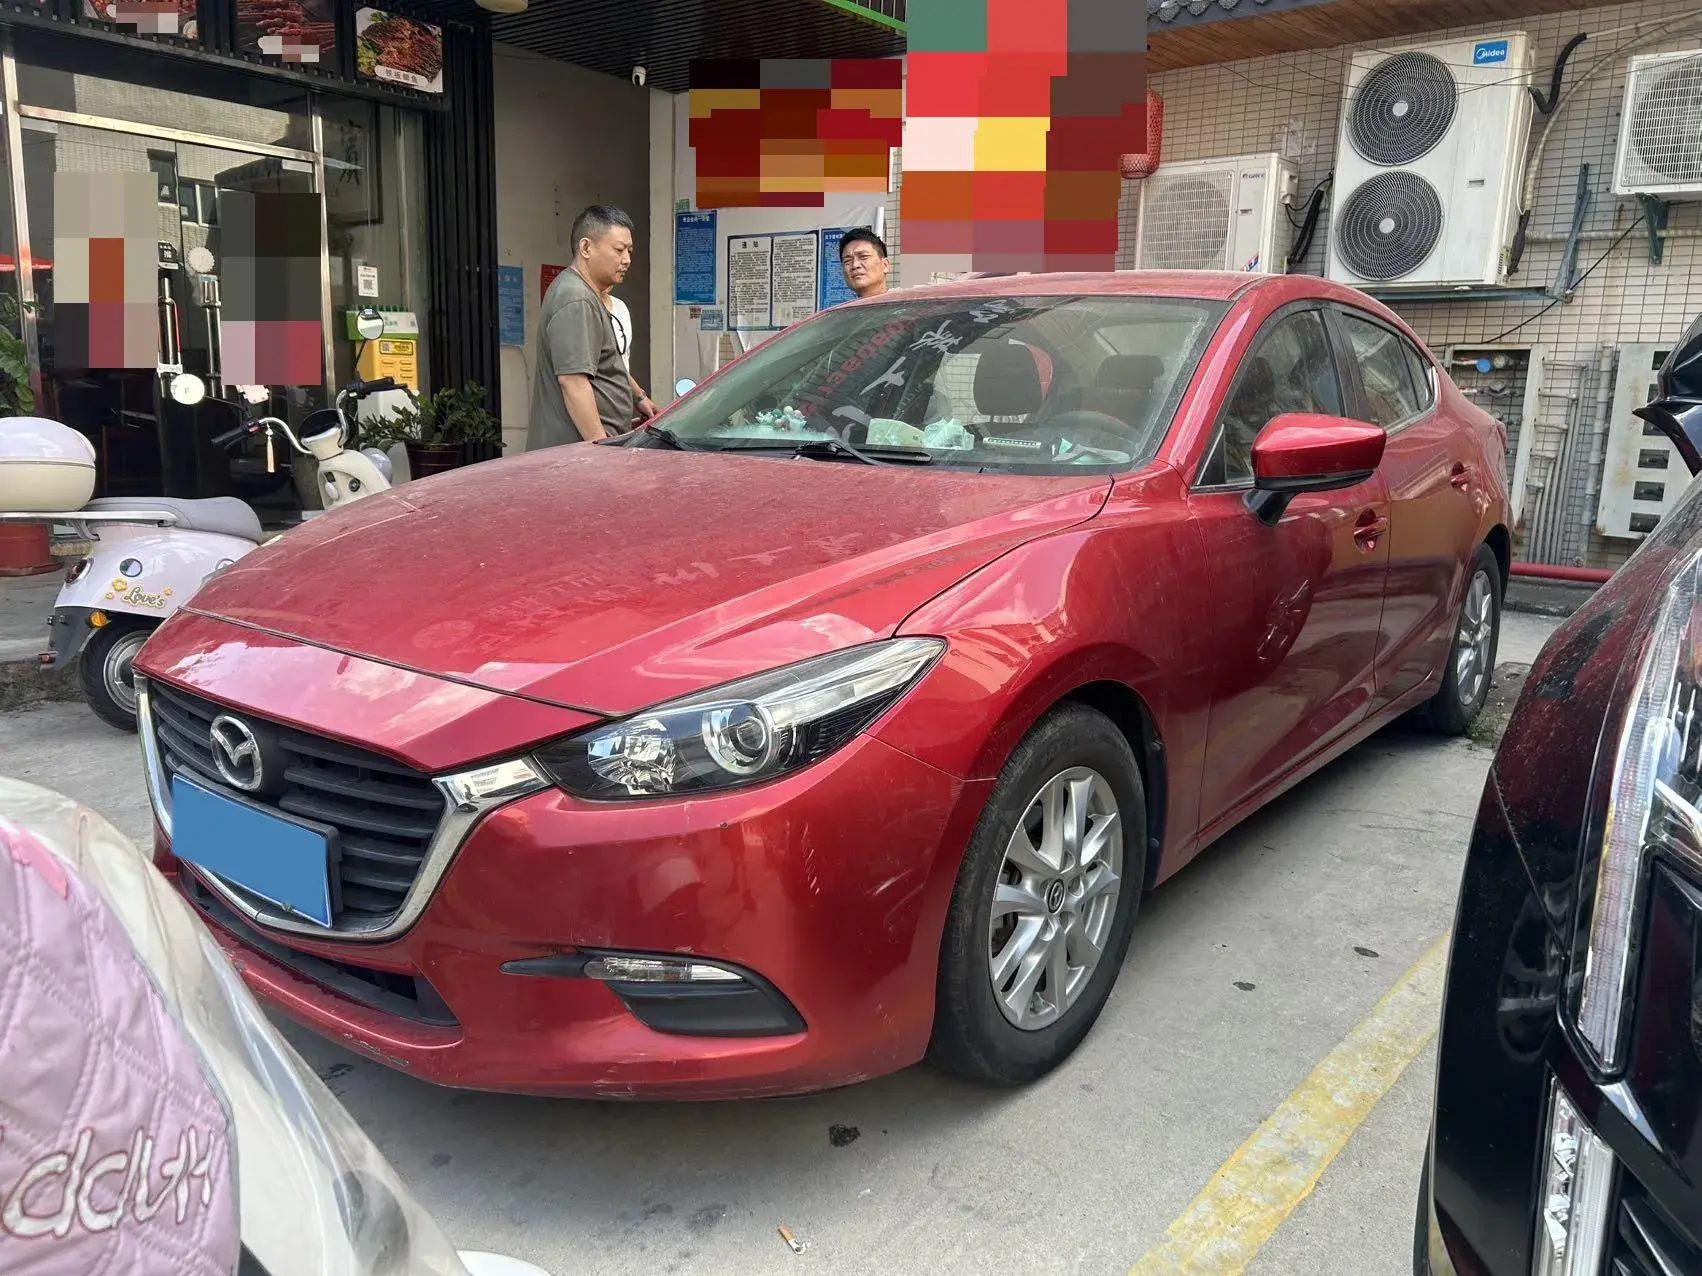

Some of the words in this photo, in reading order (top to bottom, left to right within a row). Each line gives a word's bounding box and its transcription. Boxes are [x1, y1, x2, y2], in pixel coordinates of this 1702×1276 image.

[1476, 48, 1505, 59] Midea
[123, 586, 166, 607] Love's
[0, 1125, 215, 1240] HAPP
